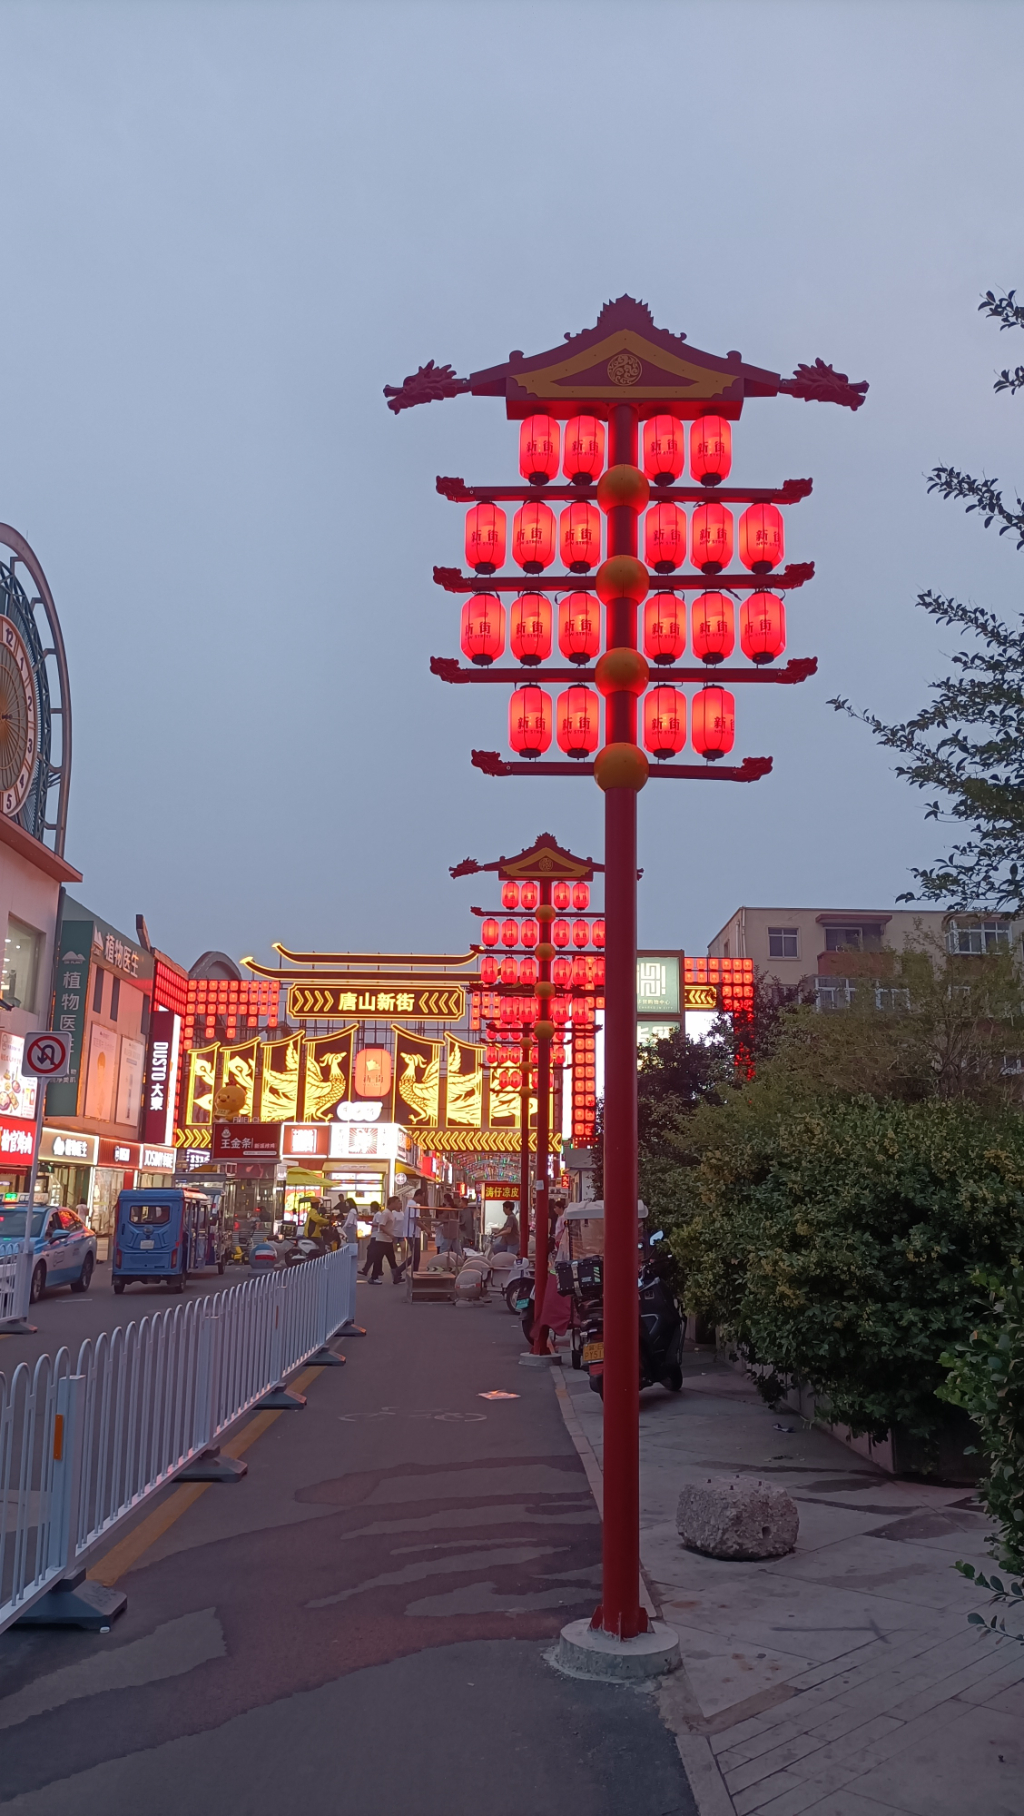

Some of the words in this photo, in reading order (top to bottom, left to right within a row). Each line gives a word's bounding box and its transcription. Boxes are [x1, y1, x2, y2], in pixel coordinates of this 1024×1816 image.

[527, 440, 553, 453] 新街
[572, 440, 598, 453] 新街
[651, 439, 675, 453] 新街
[698, 441, 725, 454] 新街
[472, 530, 498, 542] 新街
[517, 527, 542, 541] 新街
[565, 528, 592, 542] 新街
[654, 529, 680, 542] 新街
[700, 527, 727, 541] 新街
[465, 621, 491, 635] 新街
[516, 620, 543, 635] 新街
[565, 619, 592, 633] 新街
[652, 621, 680, 635] 新街
[700, 620, 727, 634] 新街
[745, 619, 772, 634] 新街
[6, 628, 13, 647] 12
[20, 657, 24, 672] 1
[28, 696, 32, 711] 2
[518, 717, 546, 730] 新街
[562, 717, 590, 730] 新街
[652, 717, 680, 730] 新街
[28, 739, 33, 754] 3
[20, 774, 24, 788] 4
[6, 794, 12, 809] 5
[105, 933, 139, 978] 植物医生
[338, 992, 415, 1011] 唐山新街
[151, 1042, 169, 1081] DUSTO
[221, 1138, 252, 1149] 王金条
[486, 1187, 519, 1198] 涛仔凉皮
